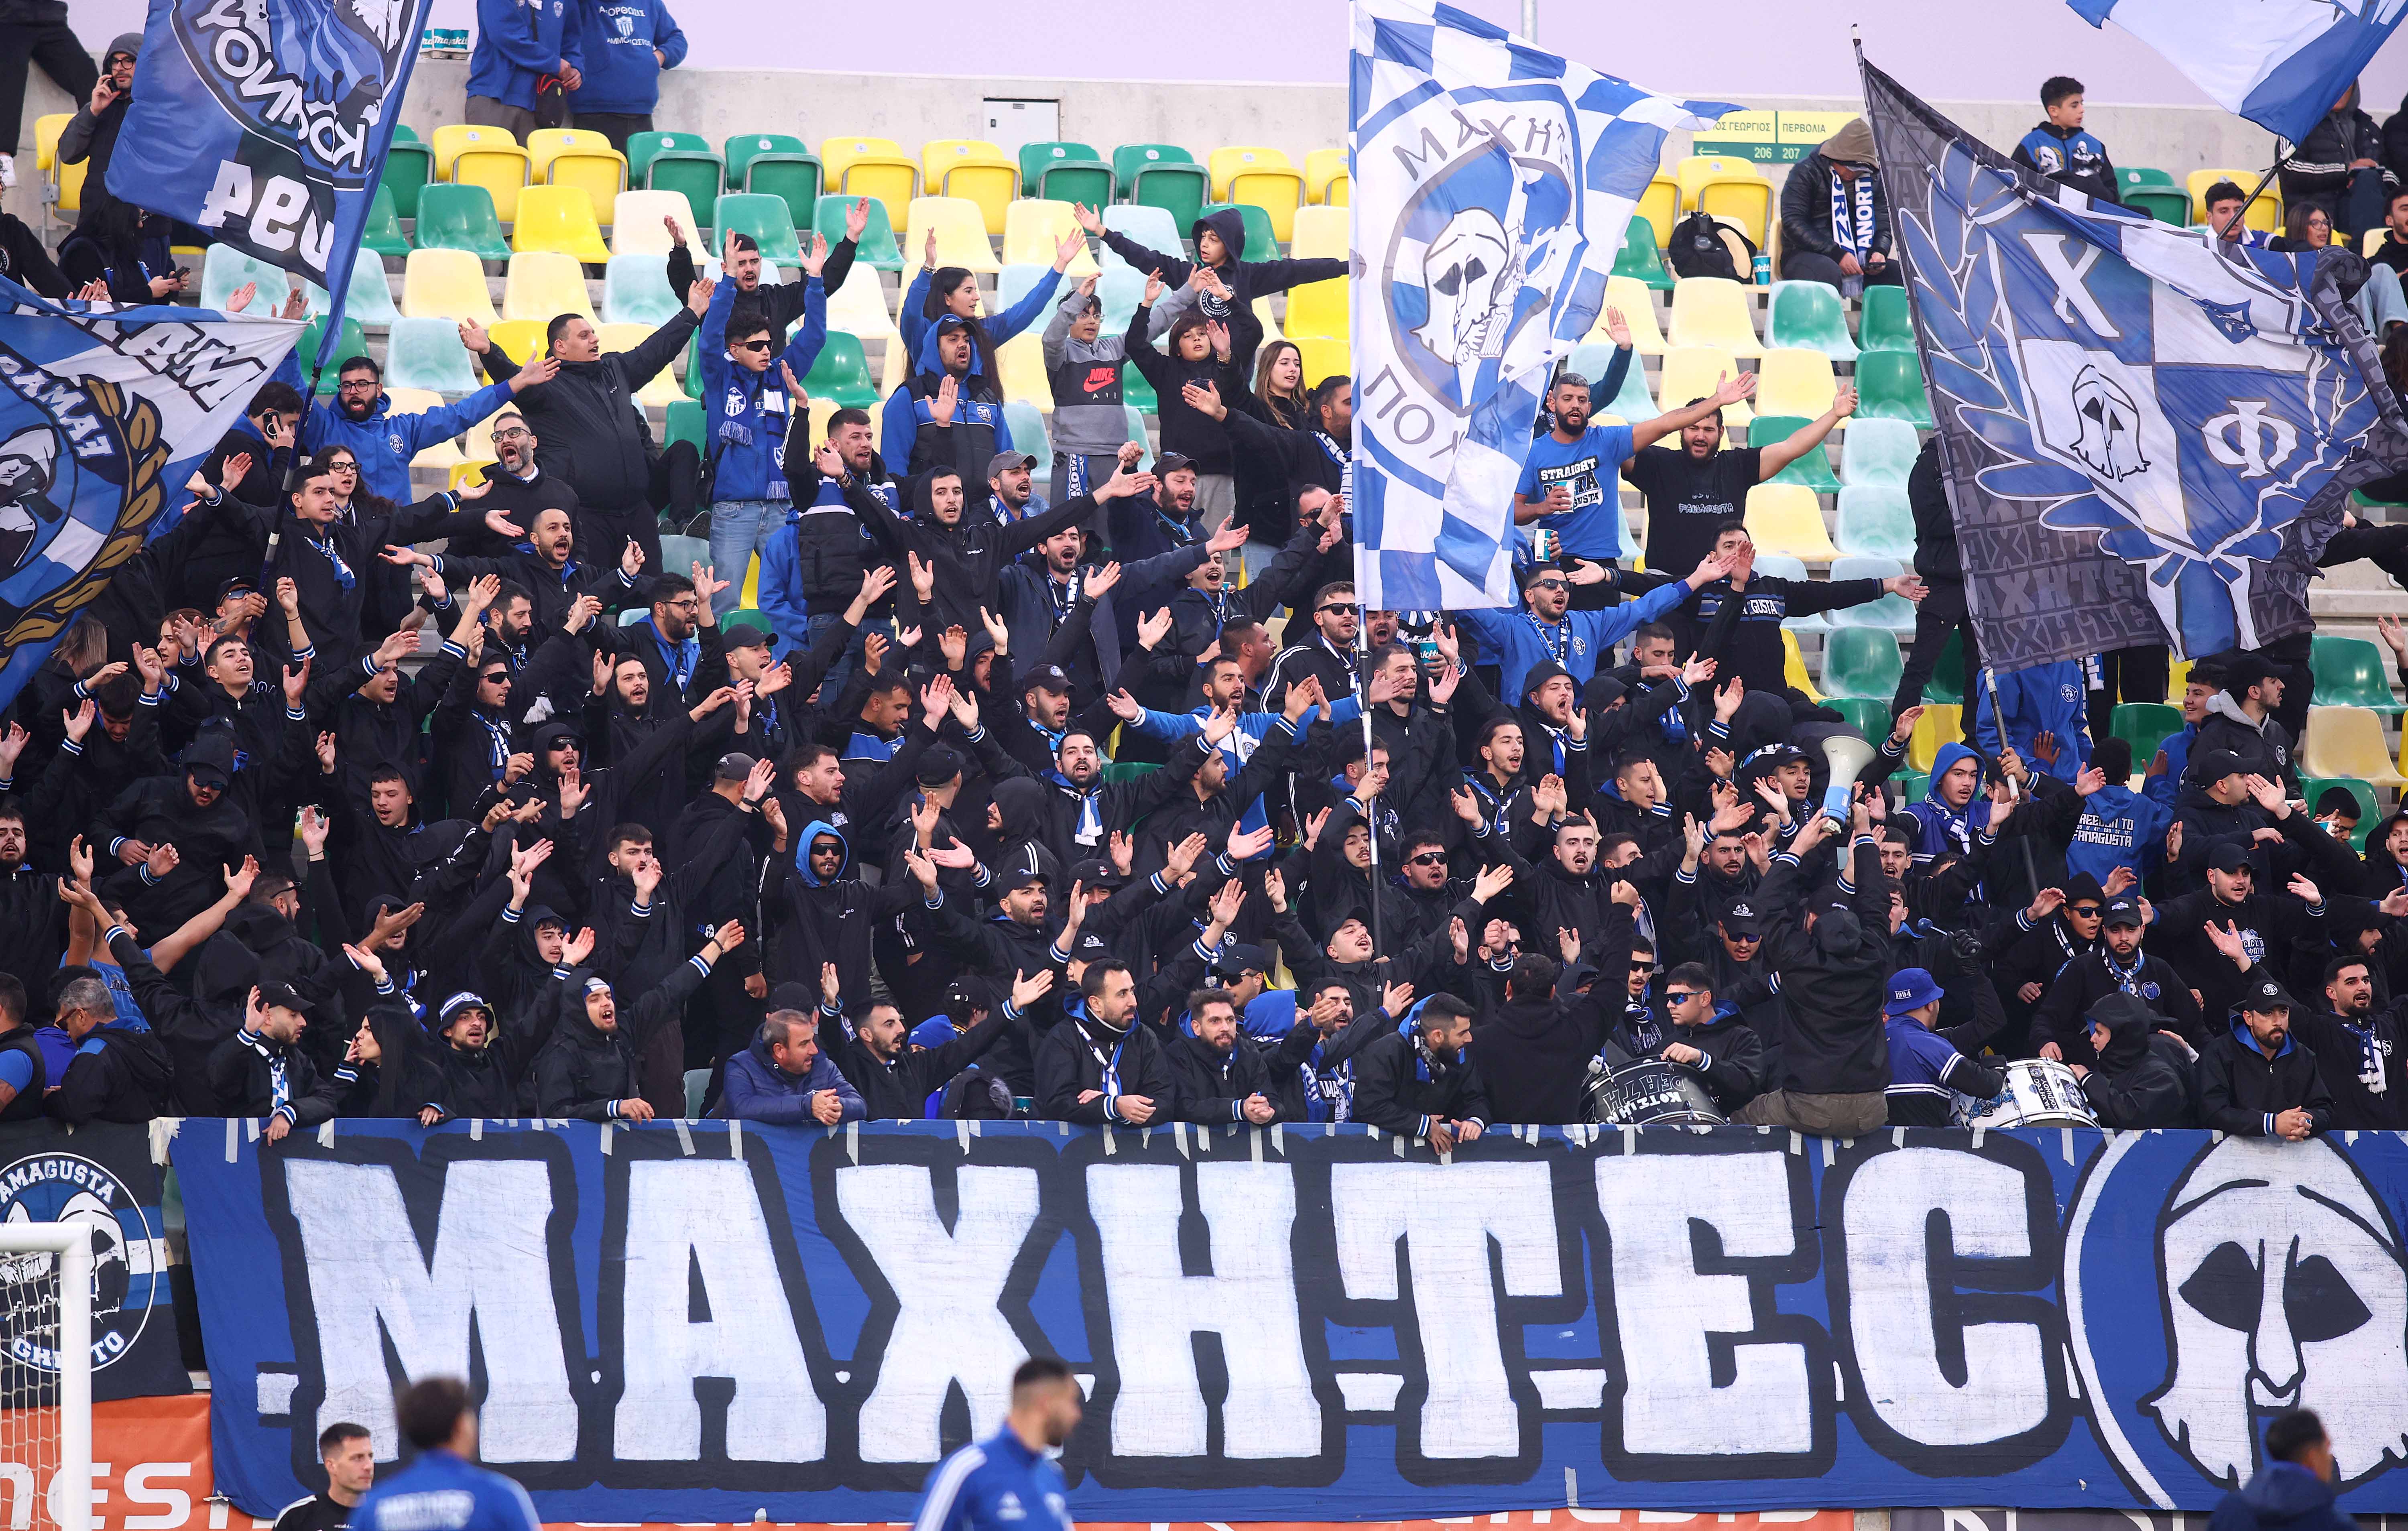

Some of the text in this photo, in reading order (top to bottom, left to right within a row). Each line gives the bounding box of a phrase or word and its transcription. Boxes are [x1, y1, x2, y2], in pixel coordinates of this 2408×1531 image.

[599, 6, 646, 17] ΑΟΡΘΩΣΙΣ
[1729, 122, 1771, 132] ΓΕΩΡΓΙΟΣ
[1782, 123, 1826, 133] ΠΕΡΒΟΛΙΑ
[1754, 147, 1772, 159] 206
[1782, 148, 1800, 159] 207
[1090, 368, 1115, 382] NIKE
[1541, 457, 1597, 481] STRAIGHT
[1678, 502, 1734, 514] FAMAGUSTA
[2121, 817, 2134, 830] TO
[2072, 830, 2133, 848] FAMAGUSTA
[1895, 990, 1911, 999] 1994
[1602, 1072, 1686, 1113] DEATH
[0, 1159, 116, 1206] AMAGUSTA
[13, 1330, 125, 1366] GHTO
